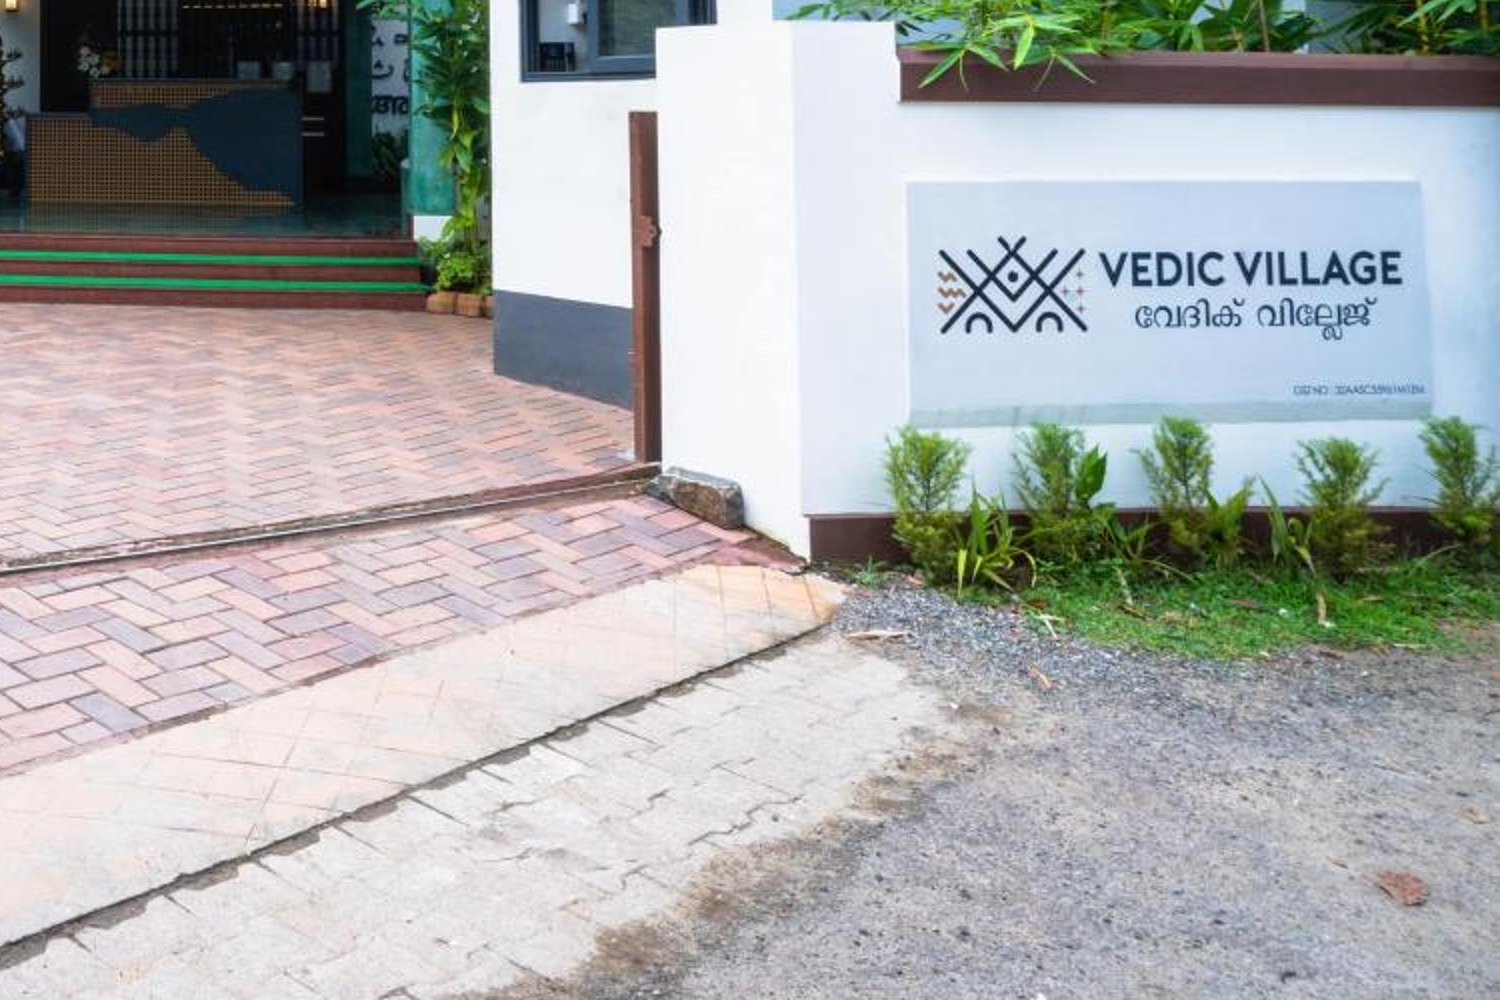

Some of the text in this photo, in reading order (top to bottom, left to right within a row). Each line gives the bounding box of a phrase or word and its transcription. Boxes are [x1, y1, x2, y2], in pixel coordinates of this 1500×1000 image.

[1098, 250, 1403, 287] VEDIC VILLAGE
[1135, 297, 1378, 341] വേദിക് വില്ലേജ്
